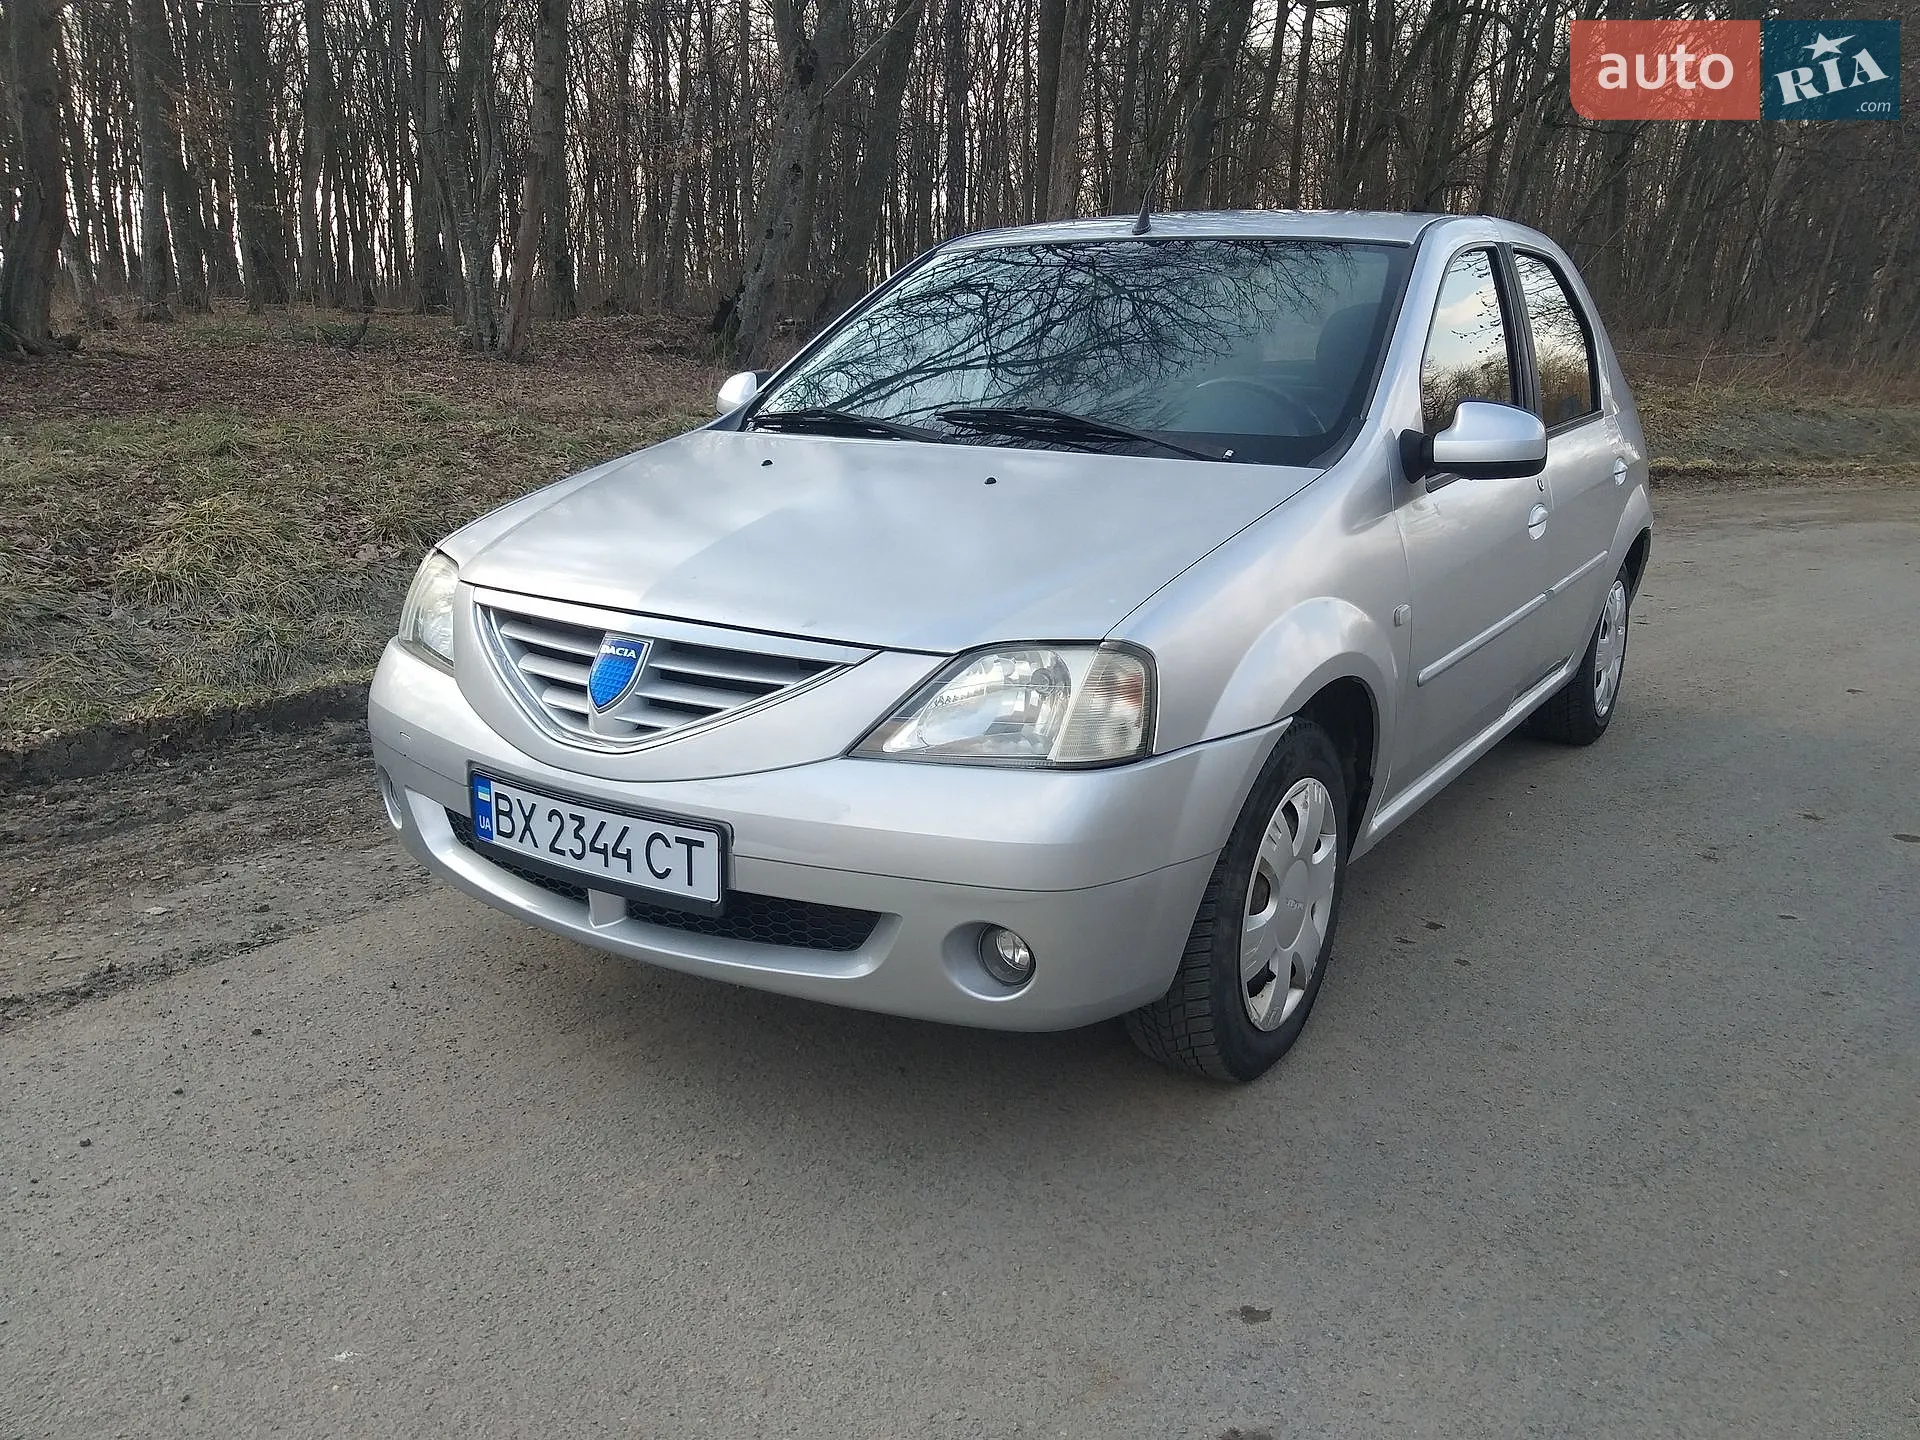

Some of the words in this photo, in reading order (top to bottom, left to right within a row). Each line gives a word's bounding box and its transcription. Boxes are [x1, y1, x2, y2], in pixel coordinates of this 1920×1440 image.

[479, 814, 492, 831] UA
[494, 791, 539, 849] BX
[547, 808, 632, 873] 2344
[645, 832, 705, 887] CT
